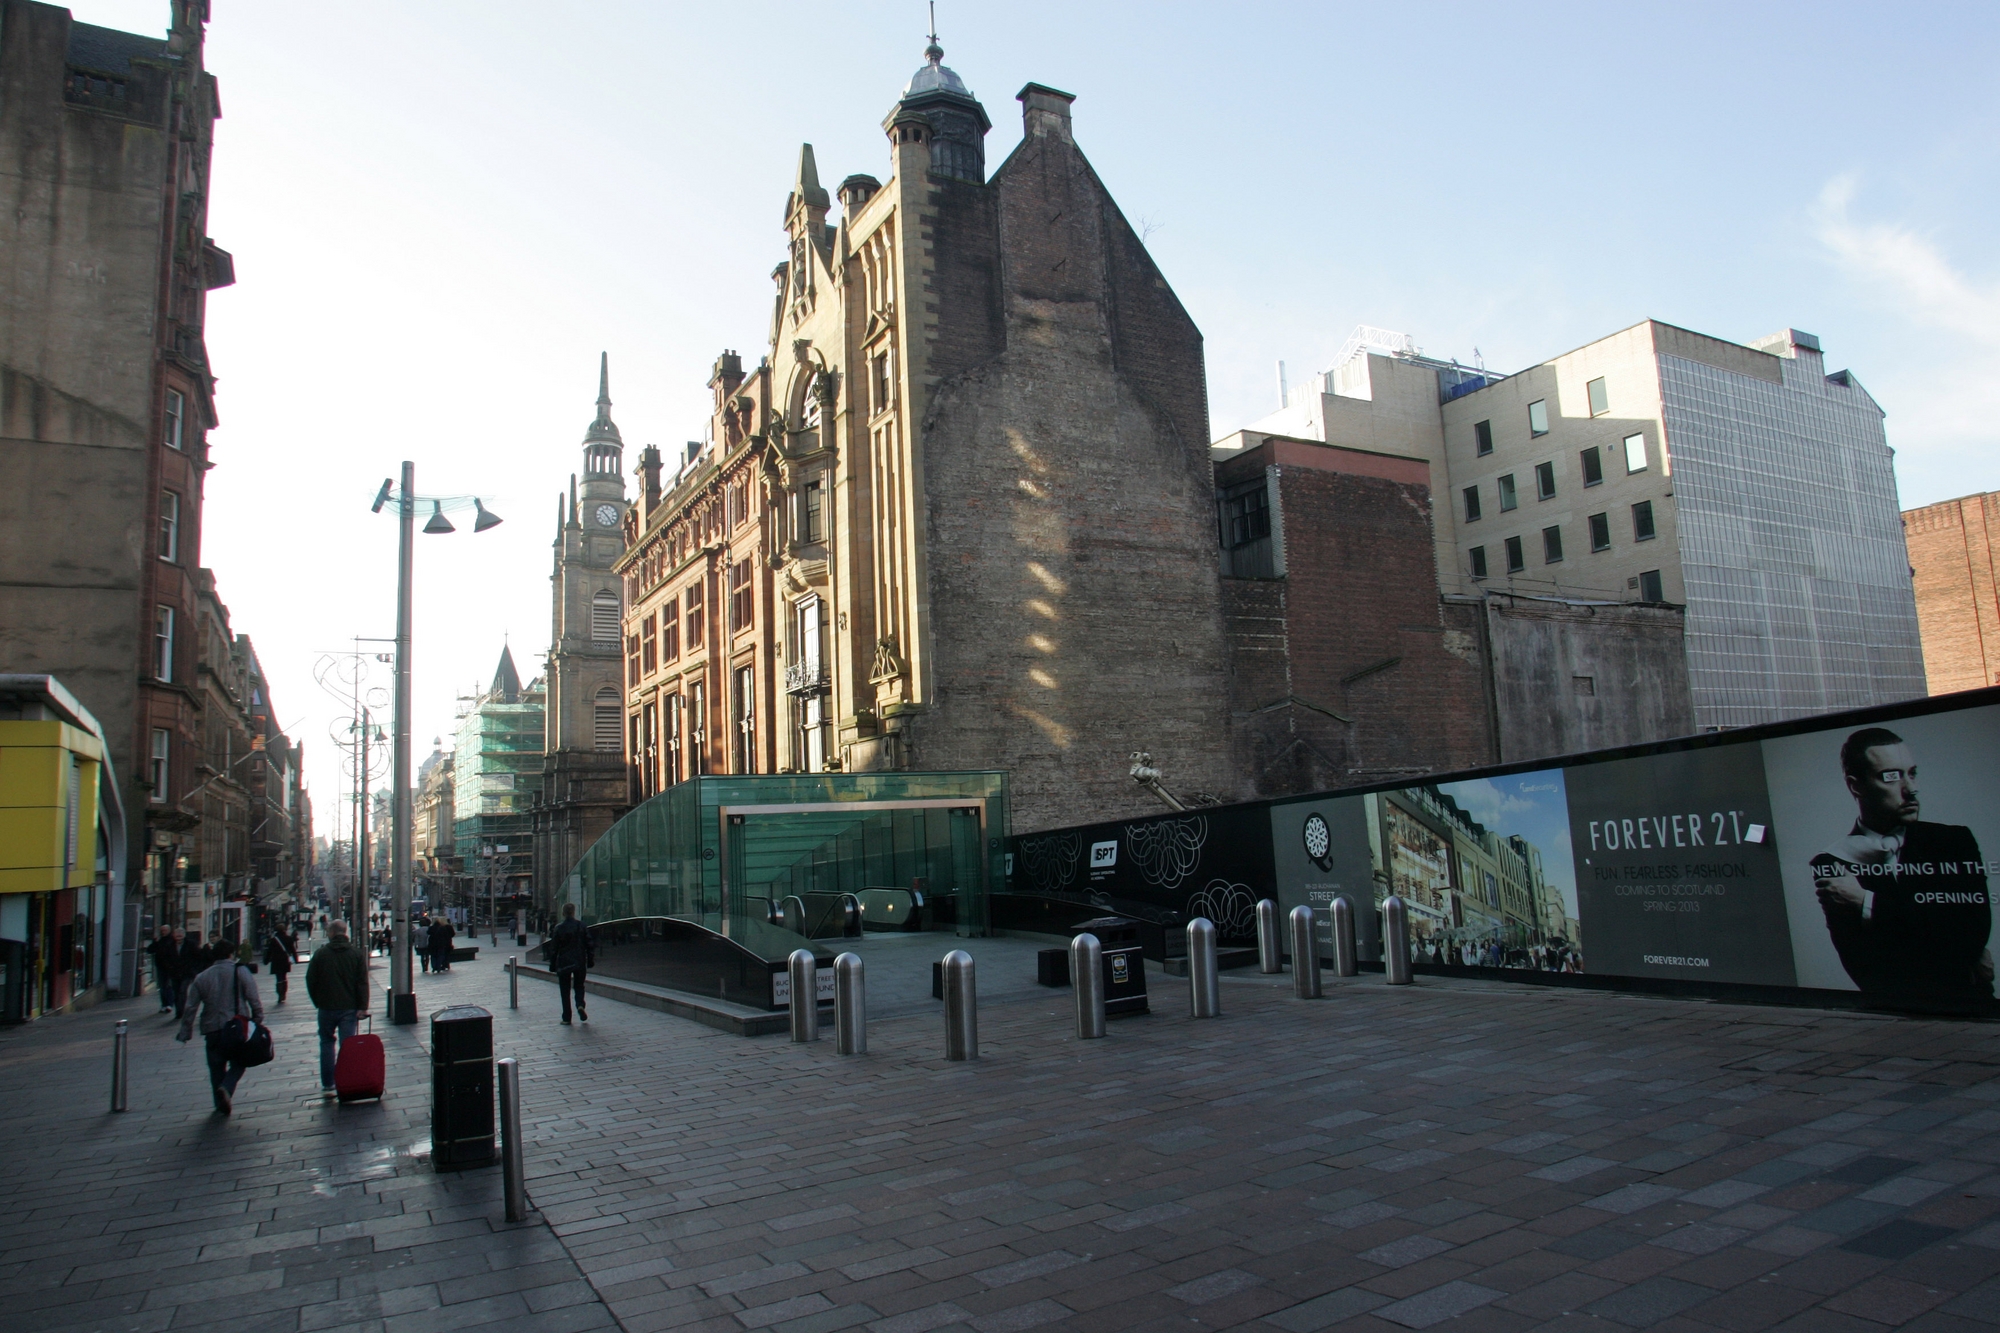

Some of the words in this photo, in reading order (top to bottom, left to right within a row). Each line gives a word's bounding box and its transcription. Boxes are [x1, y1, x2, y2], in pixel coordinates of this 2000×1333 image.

[1589, 813, 1705, 851] FOREVER
[1711, 810, 1741, 846] 21
[1094, 847, 1115, 861] SPT
[1594, 866, 1620, 881] FUN.
[1624, 864, 1682, 880] FEARLESS.
[1685, 863, 1750, 879] FASHION.
[1811, 864, 1846, 877] NEW
[1850, 862, 1934, 876] SHOPPING
[1940, 861, 1958, 875] IN
[1962, 861, 2000, 875] THE
[1309, 891, 1336, 901] STREET
[1614, 884, 1656, 896] COMING
[1657, 884, 1669, 896] TO
[1672, 884, 1726, 896] SCOTLAND
[1914, 892, 1984, 904] OPENING
[1643, 901, 1677, 912] SPRING
[1679, 900, 1700, 912] 2013
[1643, 954, 1710, 967] FOREVER21.COM
